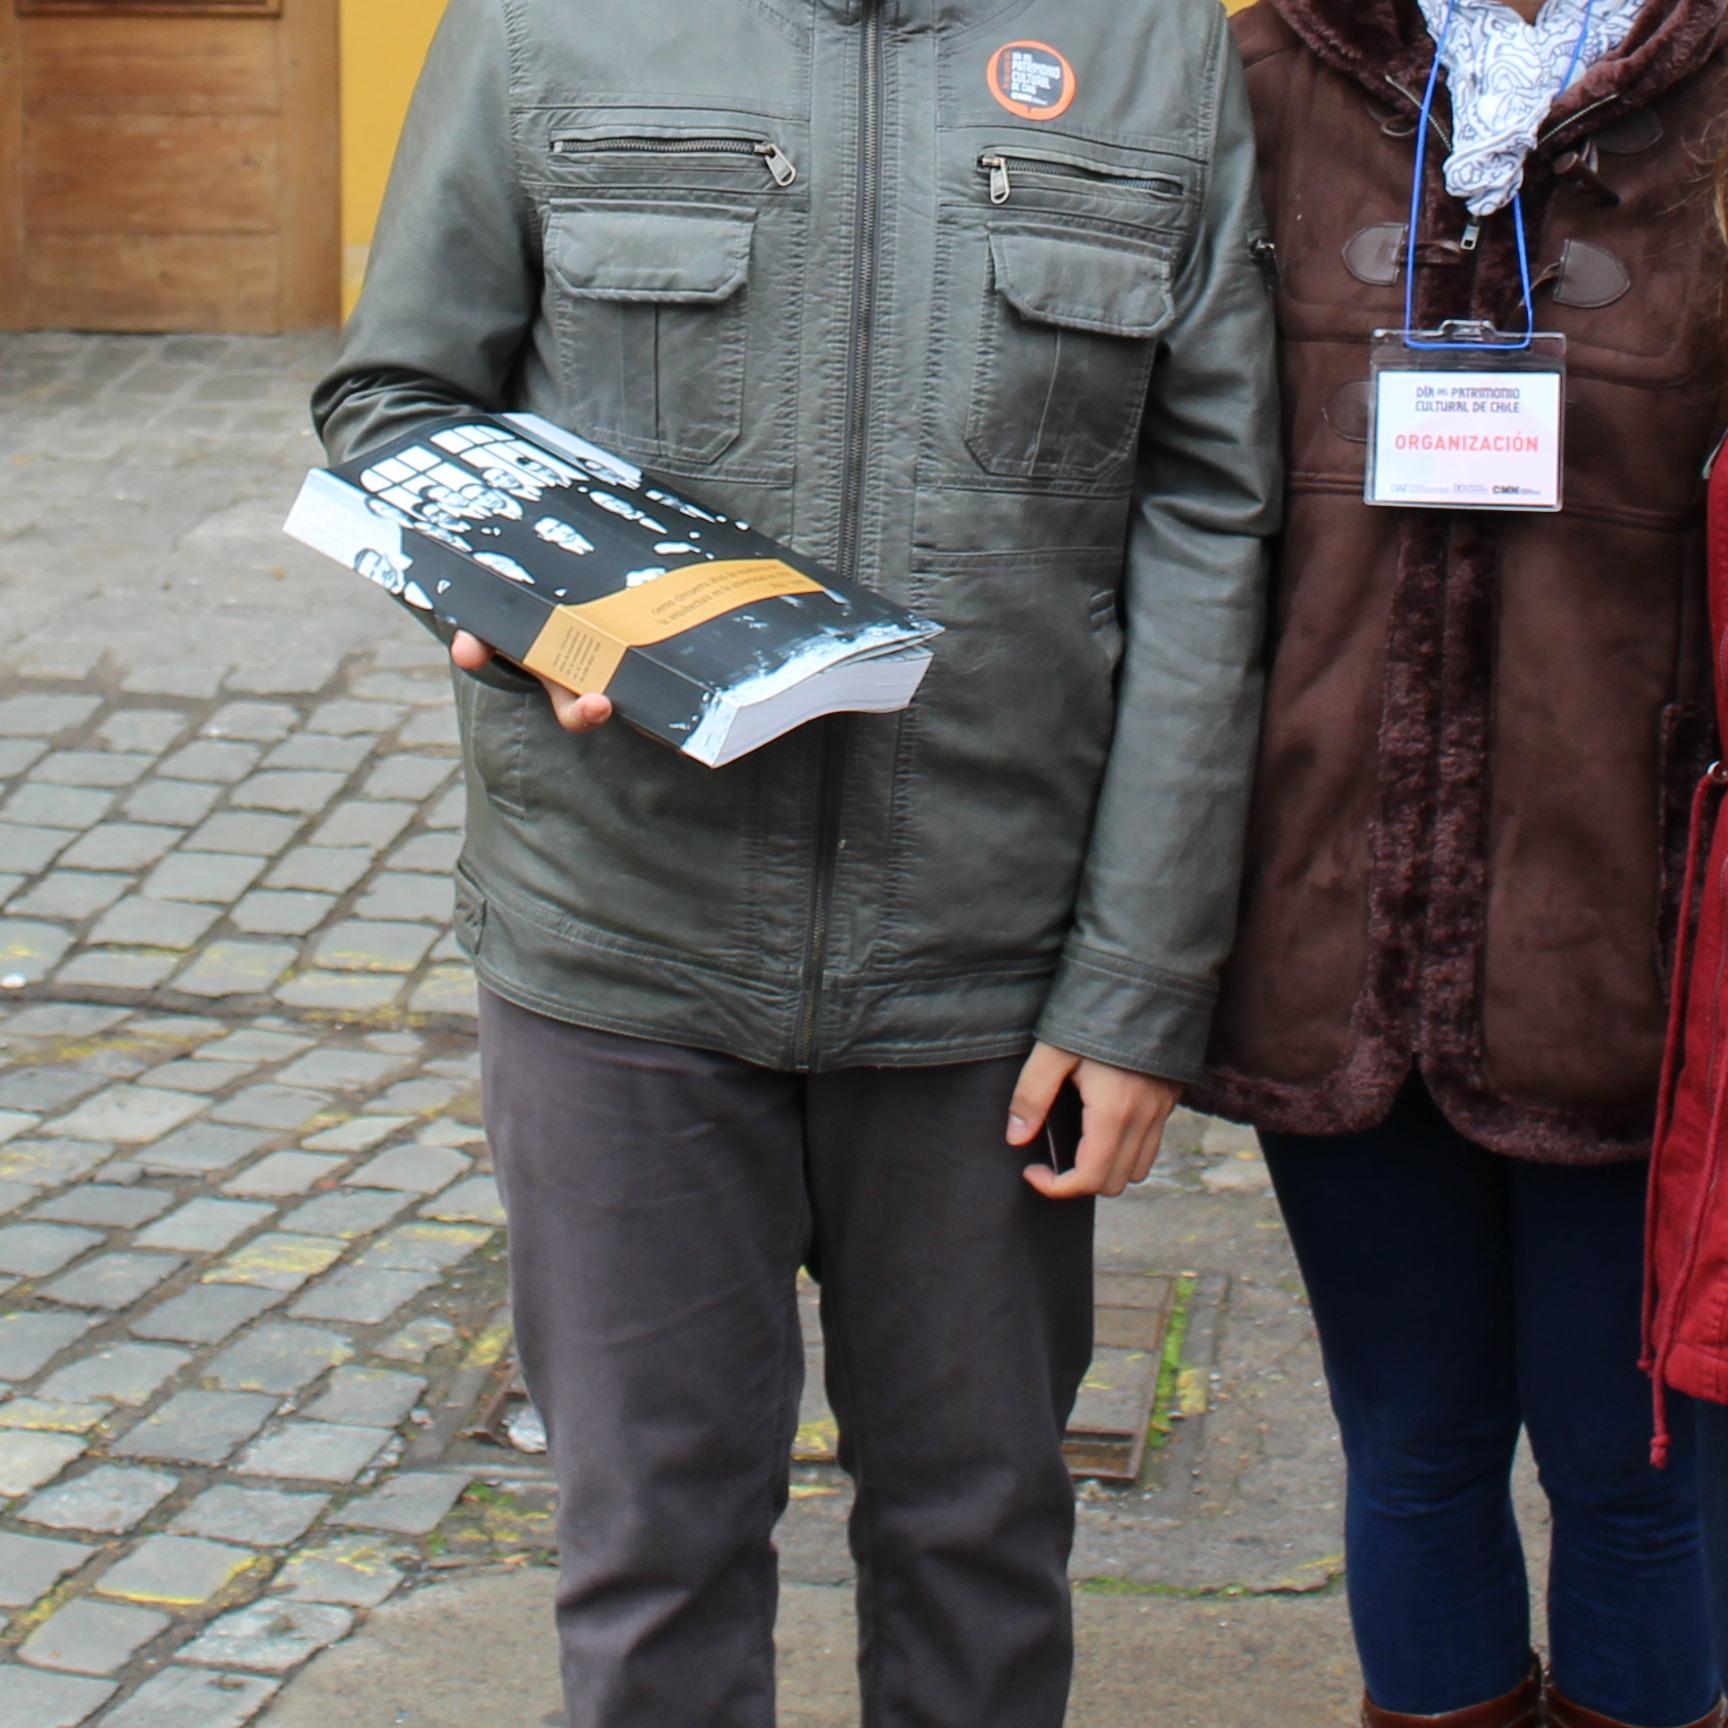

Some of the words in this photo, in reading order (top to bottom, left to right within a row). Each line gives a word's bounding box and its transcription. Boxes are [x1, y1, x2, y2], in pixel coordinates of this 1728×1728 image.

[1451, 387, 1520, 400] PATRIMONIO
[1415, 400, 1468, 412] CULTURAL
[1472, 401, 1487, 413] DE
[1395, 430, 1539, 452] ORGANIZACIÓN
